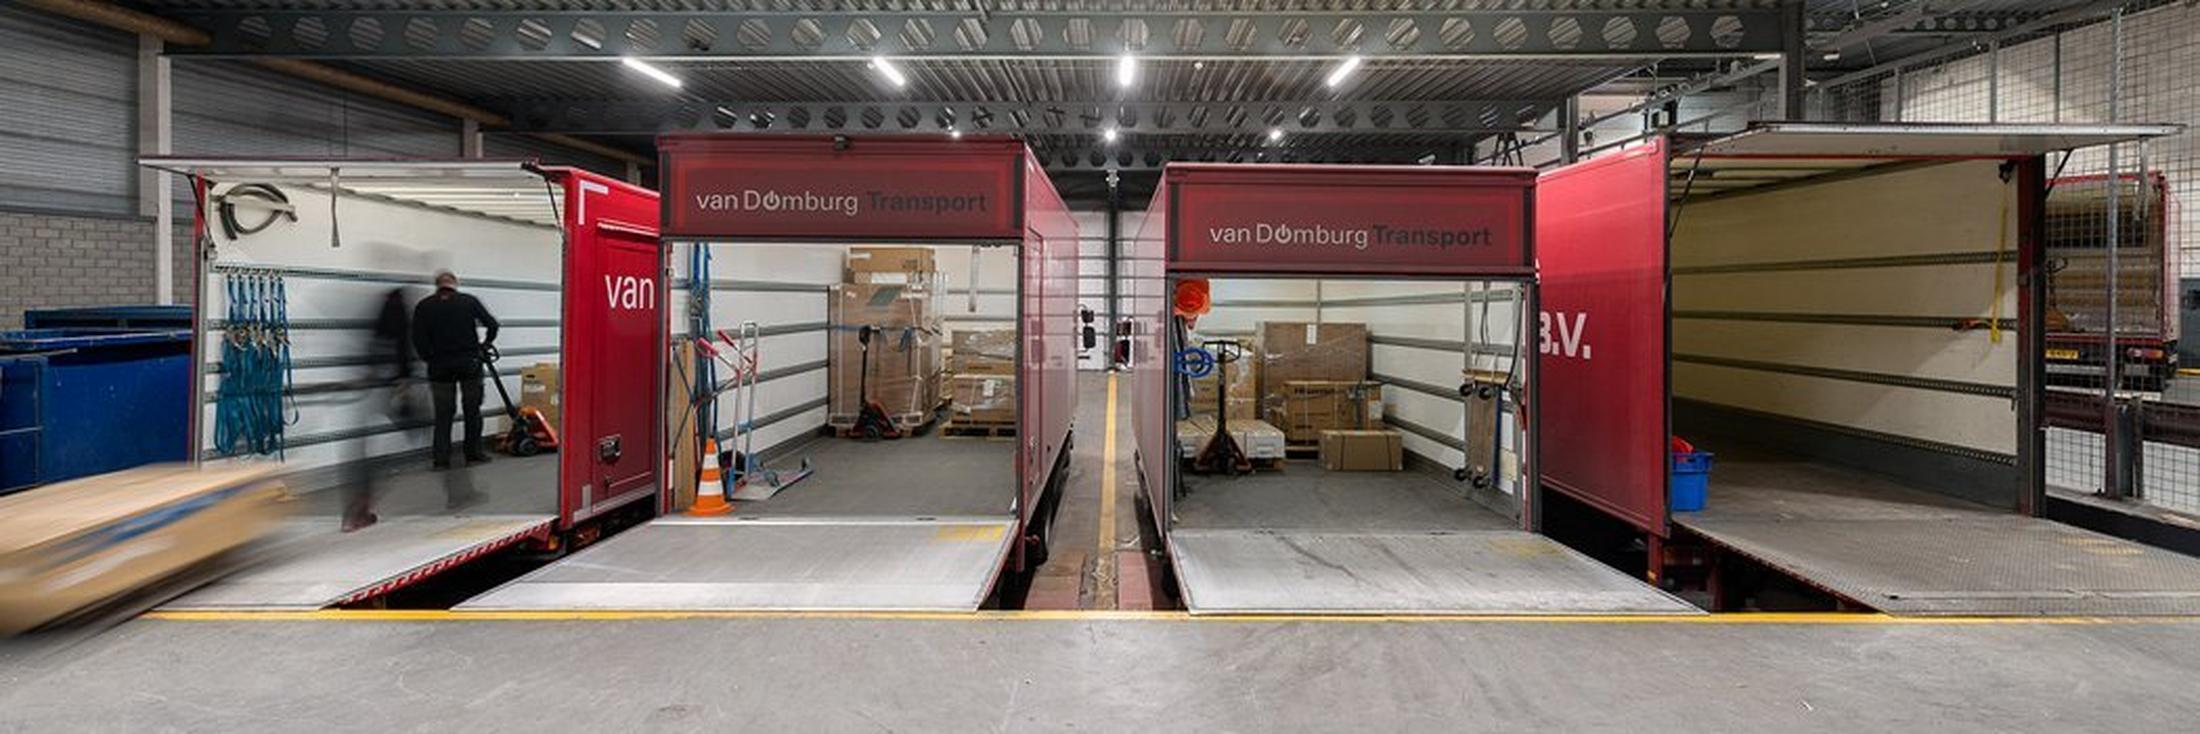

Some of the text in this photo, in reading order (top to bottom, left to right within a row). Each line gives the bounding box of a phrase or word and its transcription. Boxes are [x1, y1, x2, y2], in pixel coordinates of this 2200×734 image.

[696, 193, 738, 210] van
[868, 191, 987, 215] Transport
[1210, 227, 1250, 244] van
[1372, 225, 1493, 250] Transport
[605, 274, 654, 310] van
